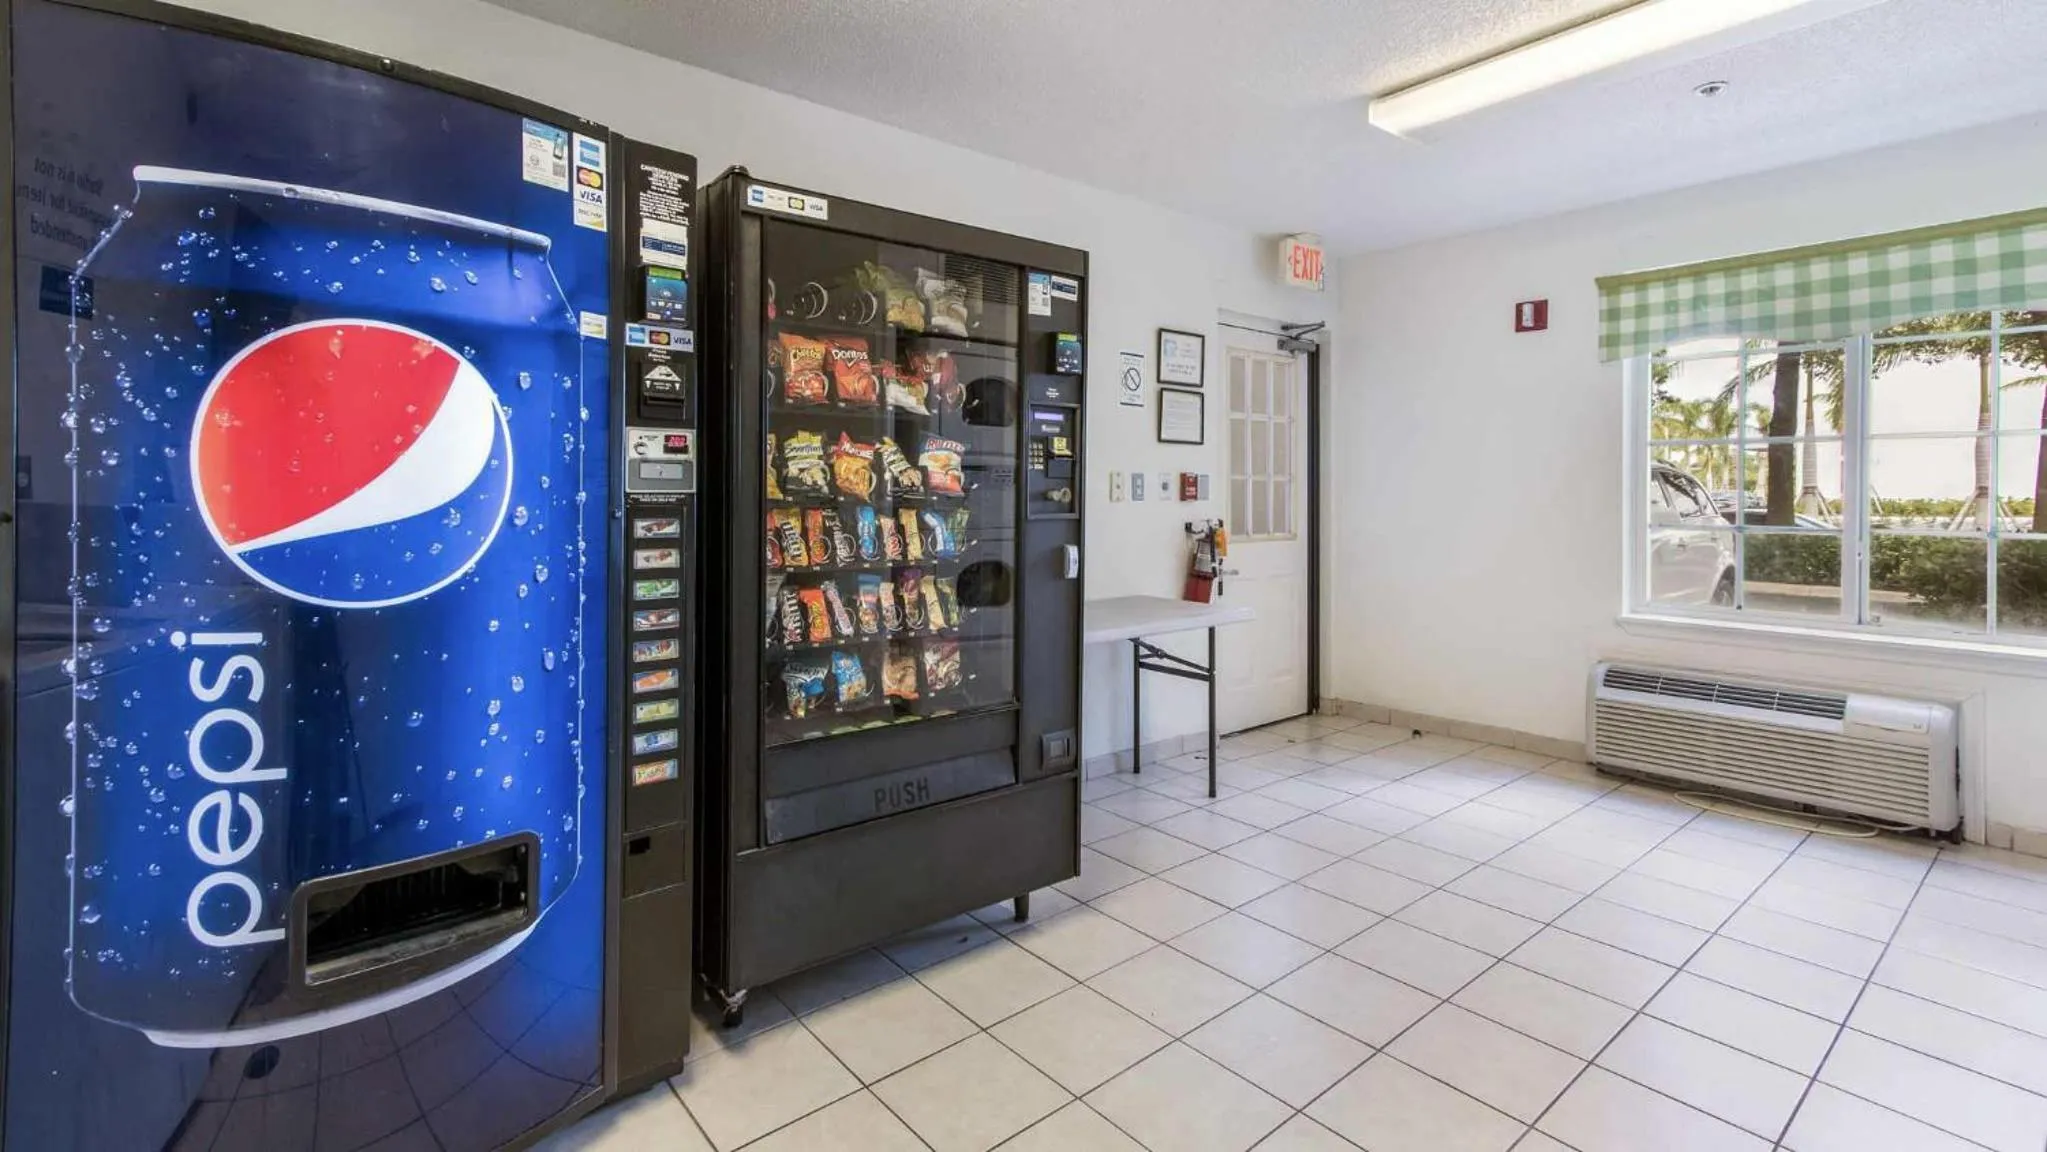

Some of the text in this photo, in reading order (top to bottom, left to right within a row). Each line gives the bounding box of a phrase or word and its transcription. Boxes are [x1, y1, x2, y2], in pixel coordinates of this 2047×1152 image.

[580, 190, 603, 204] VISA
[809, 203, 824, 212] VISA
[1293, 244, 1321, 282] EXIT
[673, 336, 692, 346] VISA
[170, 630, 288, 948] pepsi
[873, 775, 931, 814] PUSH
